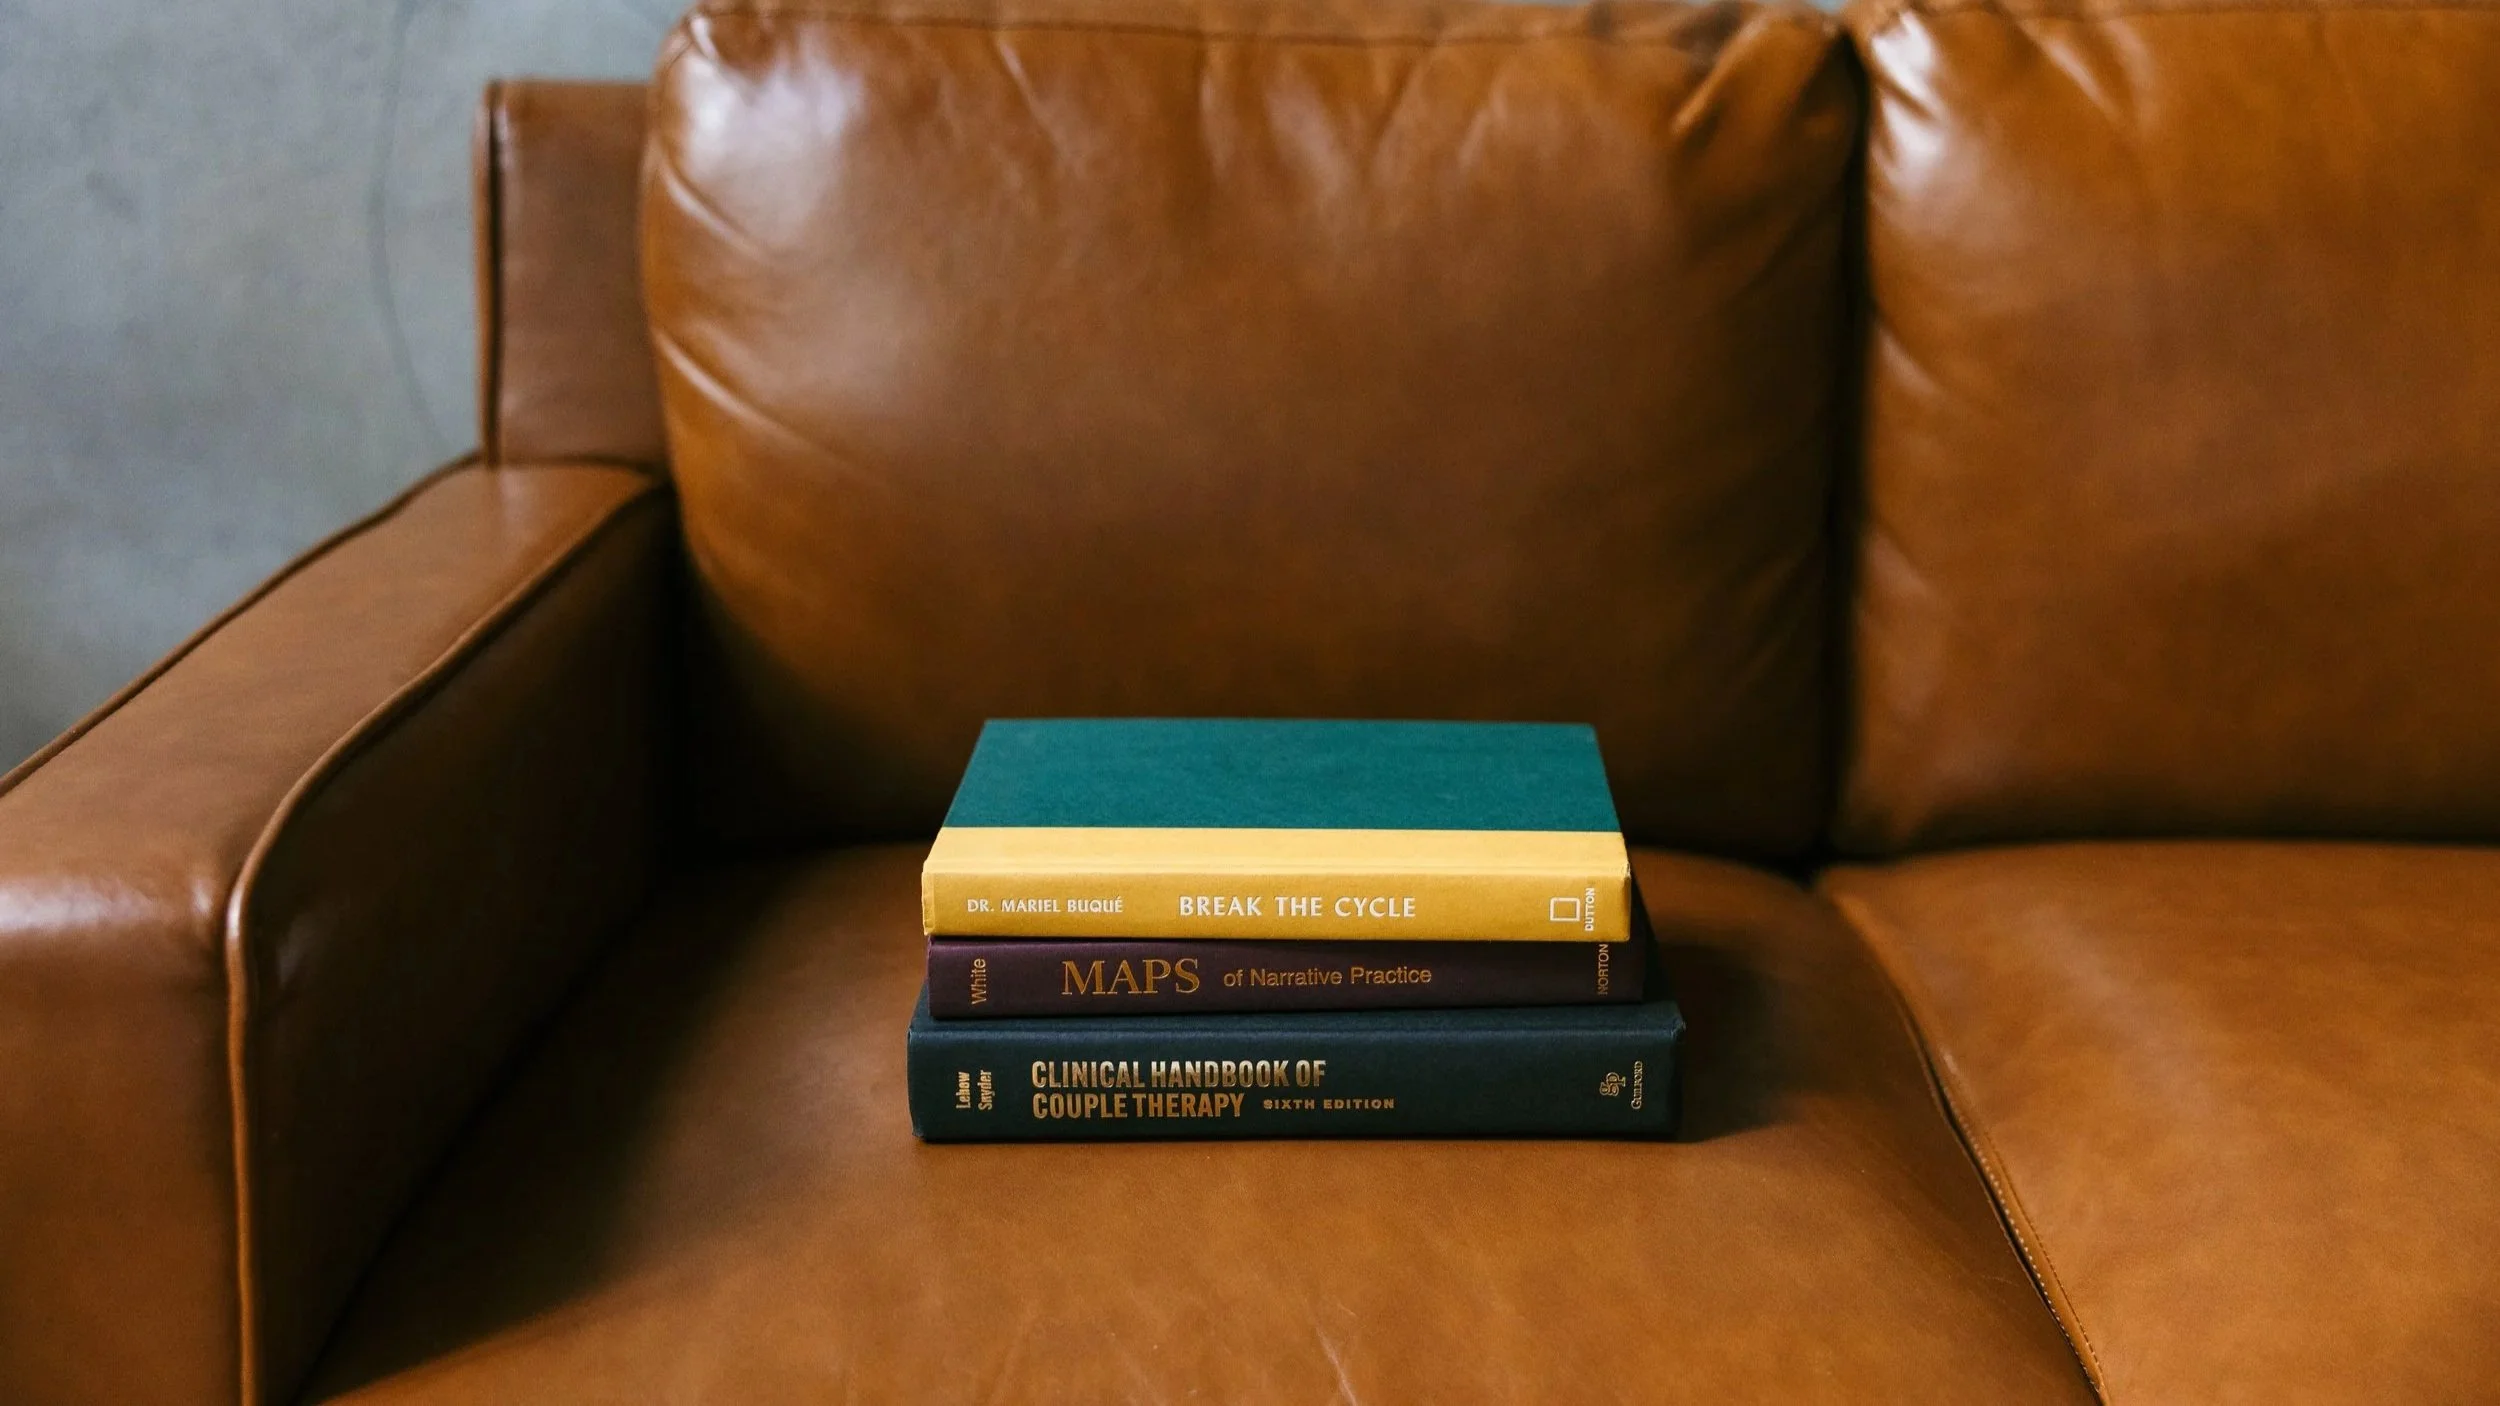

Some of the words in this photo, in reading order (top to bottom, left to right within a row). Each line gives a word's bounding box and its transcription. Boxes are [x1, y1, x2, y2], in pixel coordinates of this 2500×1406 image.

[967, 899, 994, 912] DR.
[1001, 899, 1061, 913] MARIEL
[1067, 895, 1123, 913] BUQUÉ
[1179, 896, 1262, 917] BREAK
[1274, 896, 1322, 917] THE
[1334, 896, 1416, 918] CYCLE
[1584, 887, 1596, 931] DUTTON
[971, 958, 986, 1005] White
[1061, 958, 1201, 996] MAPS
[1223, 969, 1243, 987] of
[1250, 967, 1343, 987] Narrative
[1350, 965, 1432, 985] Practice
[1598, 943, 1610, 996] NORTON
[977, 1069, 994, 1110] Snyder
[1031, 1060, 1146, 1088] CLINICAL
[1151, 1060, 1290, 1088] HANDBOOK
[1296, 1059, 1327, 1088] OF
[1032, 1093, 1133, 1119] COUPLE
[1135, 1092, 1245, 1118] THERAPY
[1263, 1099, 1315, 1110] SIXTH
[1323, 1098, 1395, 1110] EDITION
